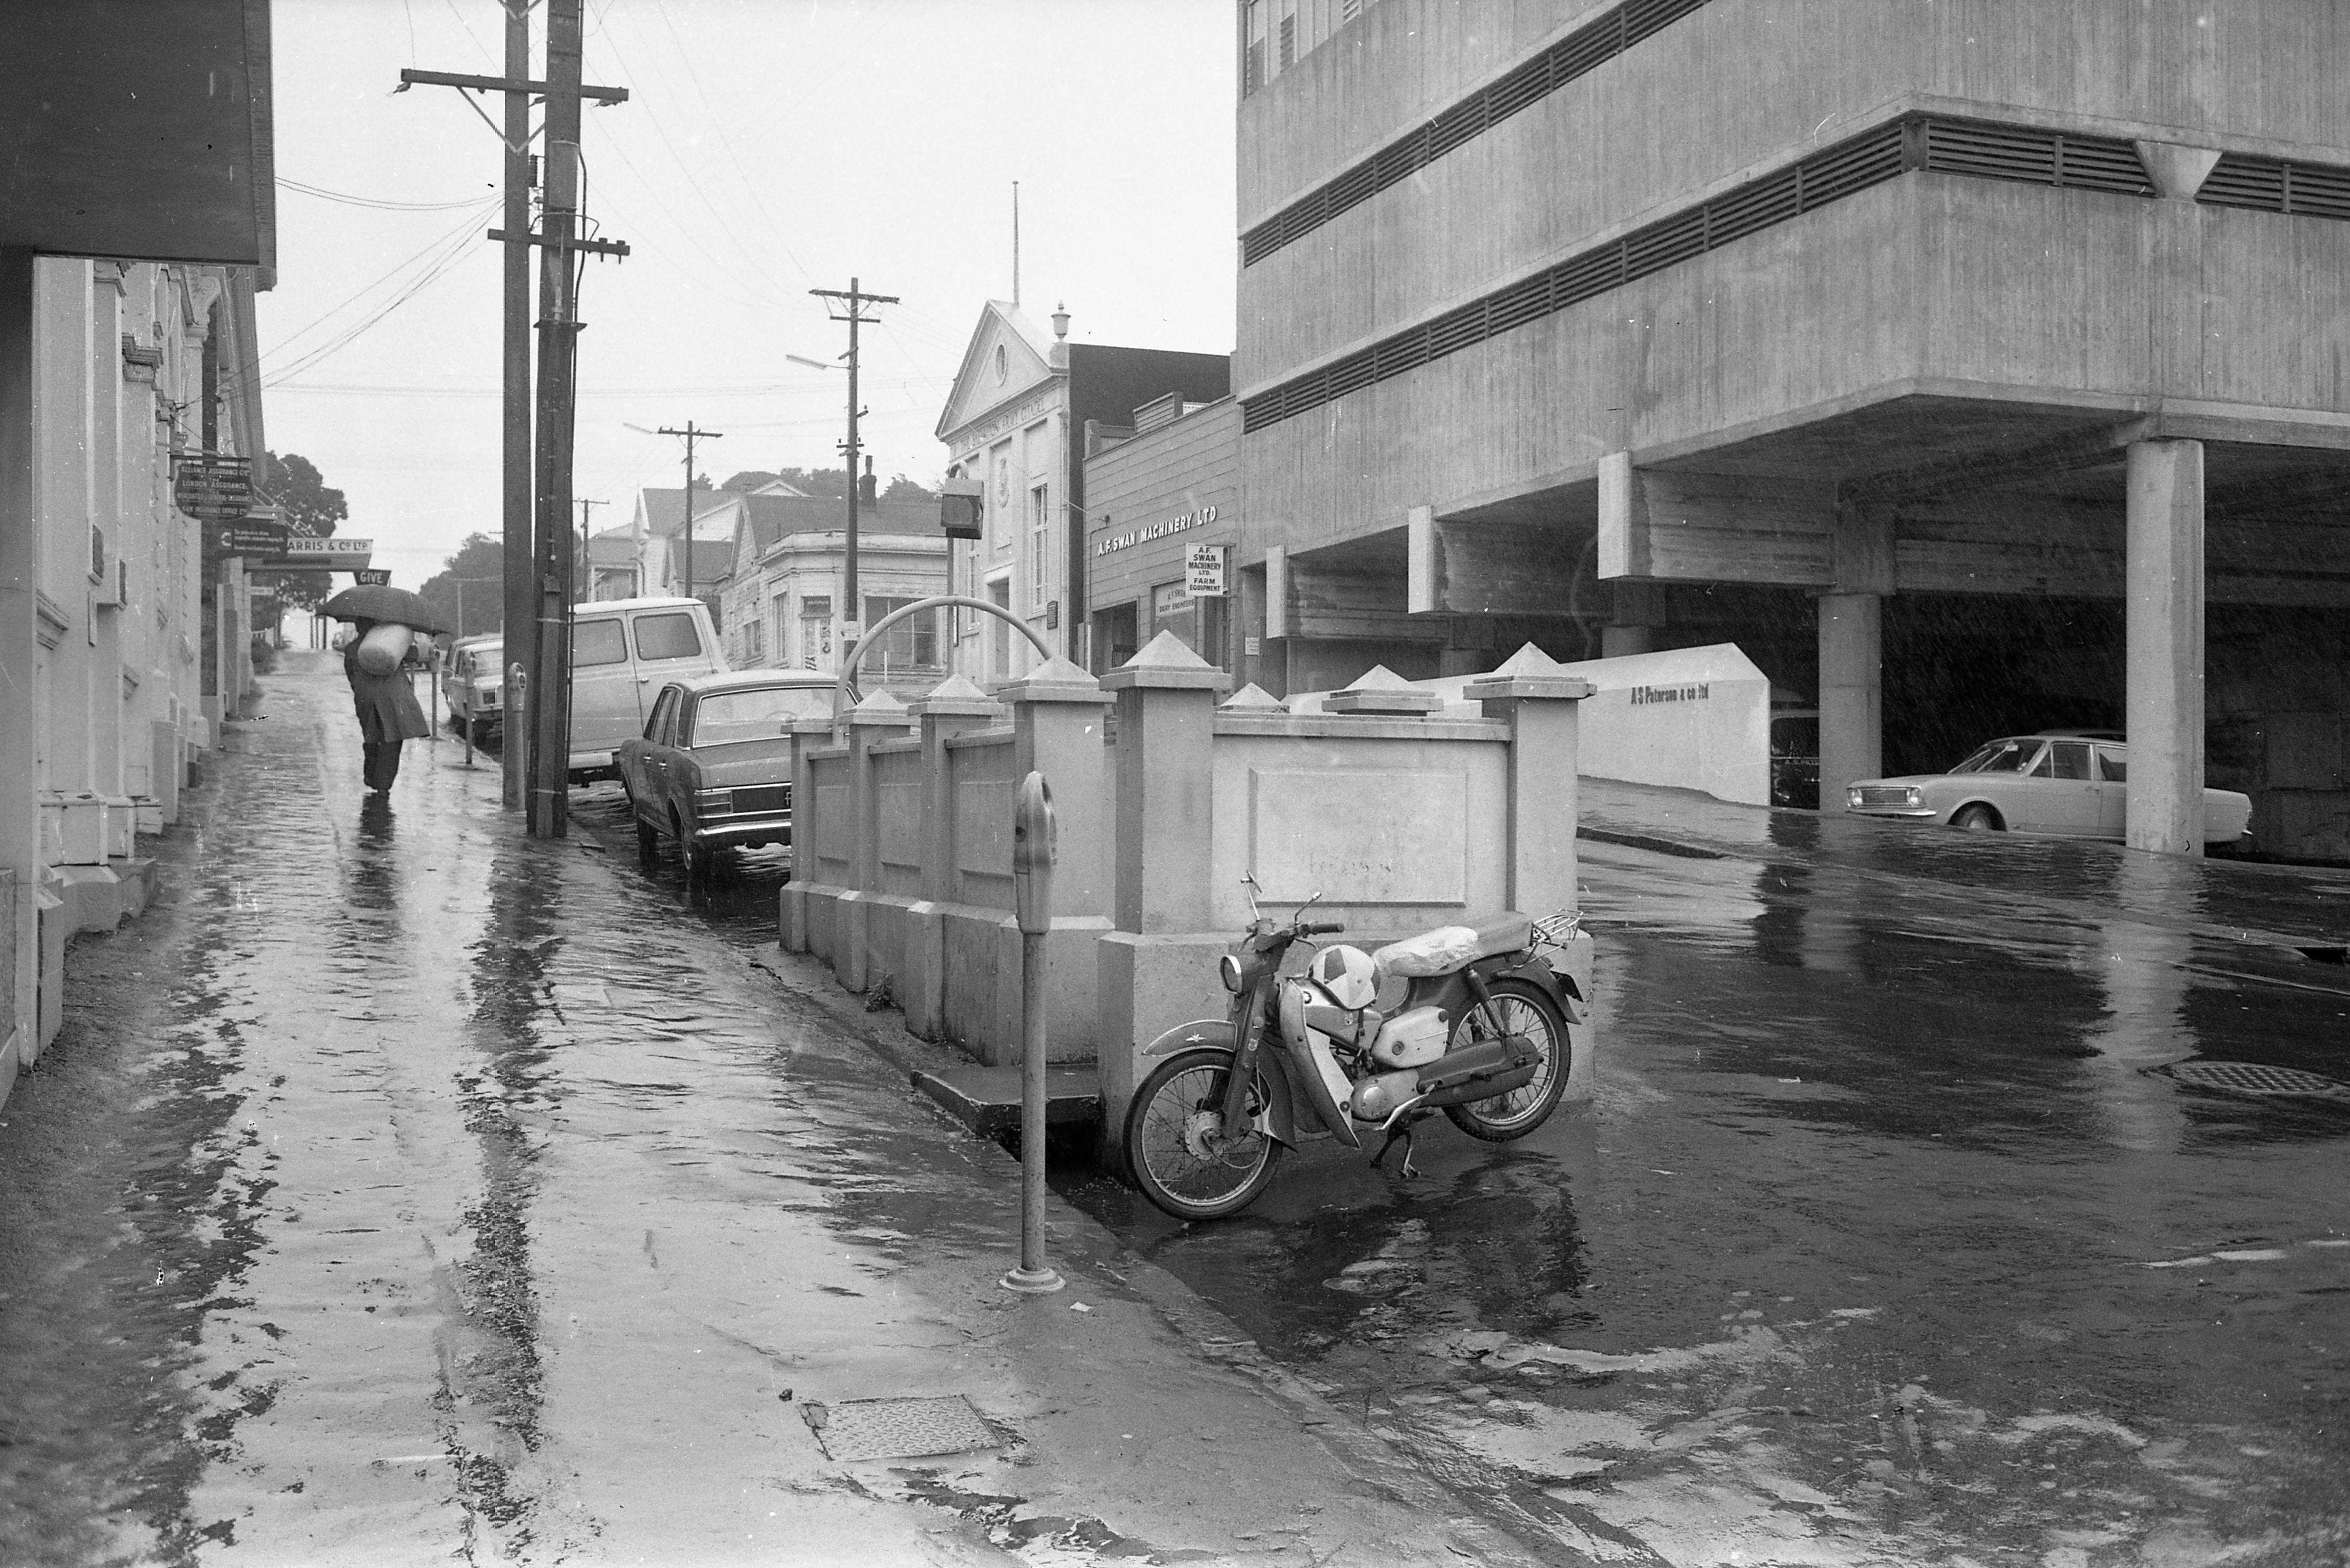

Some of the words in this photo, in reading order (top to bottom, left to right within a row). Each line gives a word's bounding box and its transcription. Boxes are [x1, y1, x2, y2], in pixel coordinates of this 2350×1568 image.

[1021, 397, 1045, 421] CITADEL
[1141, 513, 1193, 544] MACHINERY
[1197, 506, 1217, 526] LTD
[327, 541, 334, 551] &
[360, 572, 382, 583] GIVE
[1172, 599, 1194, 610] ENGINEERS
[1645, 686, 1677, 703] Paterson
[1680, 688, 1685, 701] &
[1699, 683, 1708, 699] ltd
